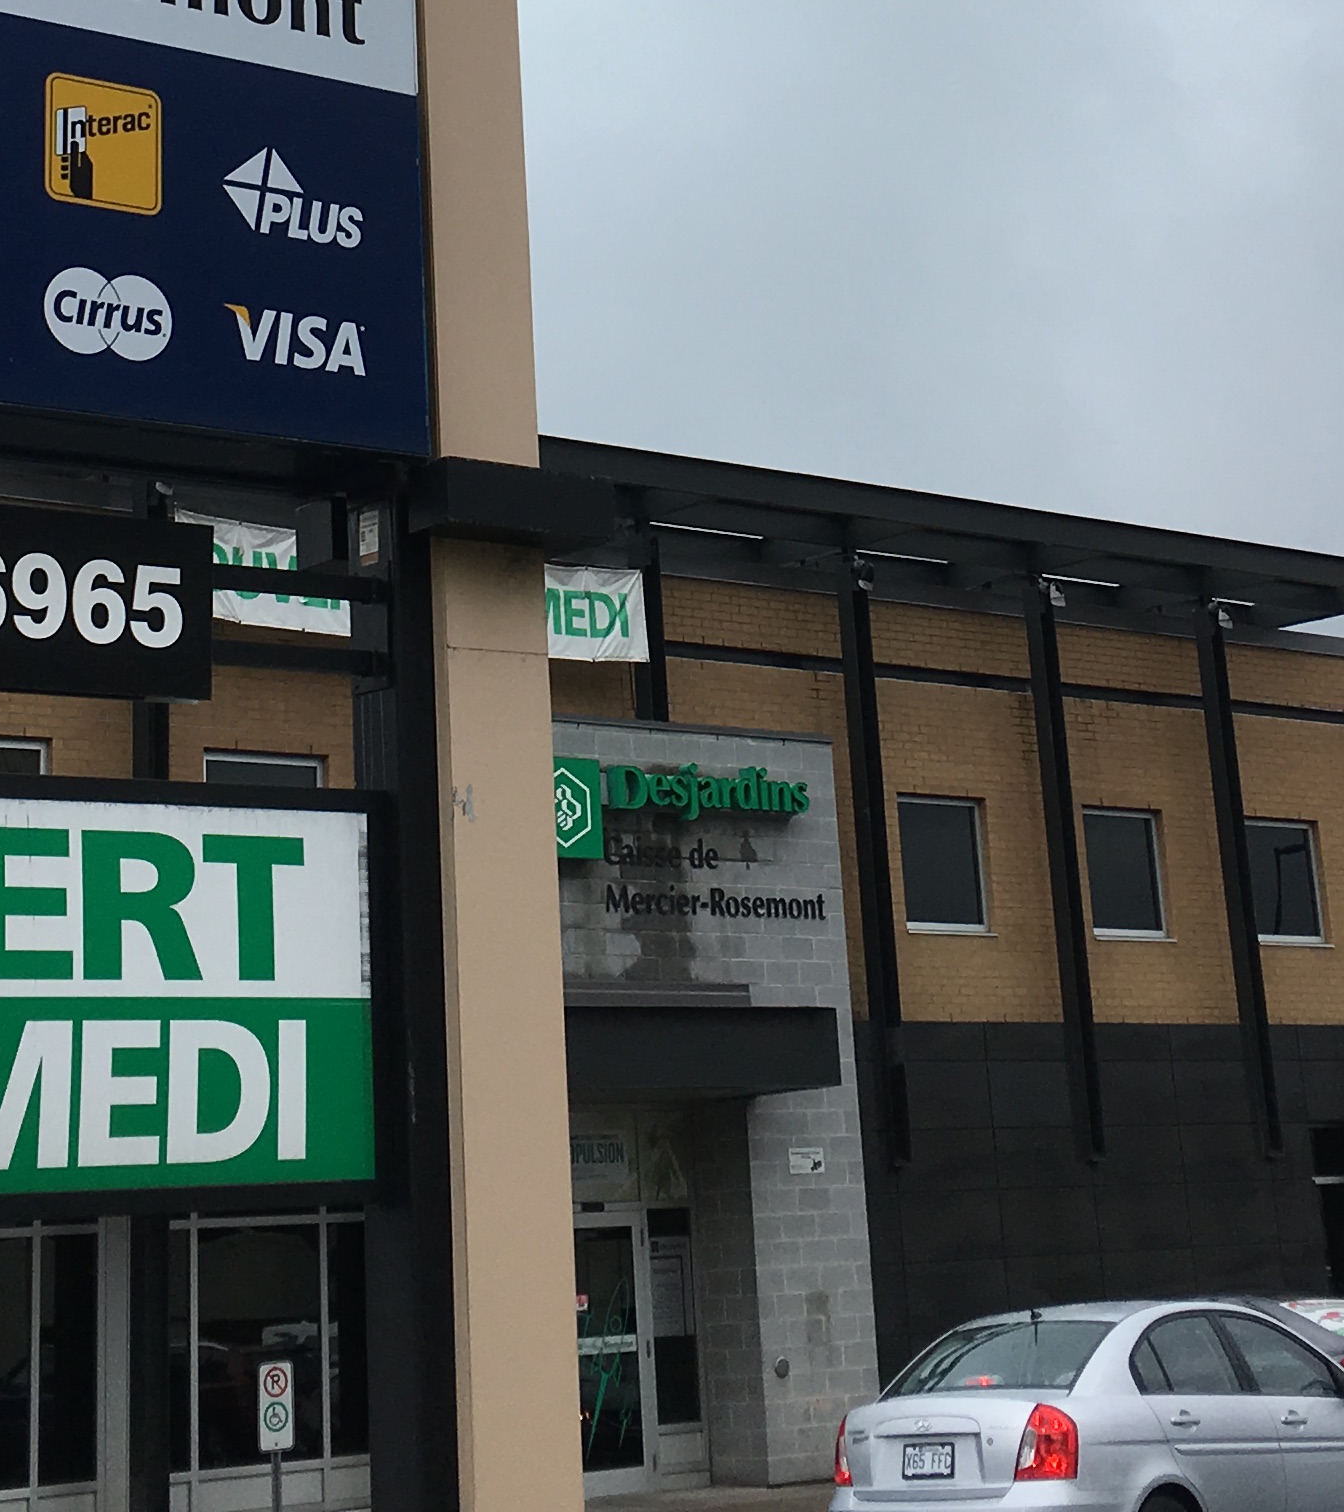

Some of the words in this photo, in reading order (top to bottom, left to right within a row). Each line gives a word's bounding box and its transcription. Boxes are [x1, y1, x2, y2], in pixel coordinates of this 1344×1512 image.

[62, 107, 151, 155] Interac
[260, 193, 364, 248] PLUS
[53, 289, 164, 337] Cirrus
[224, 303, 366, 377] VISA
[607, 763, 809, 820] Desjardins
[689, 839, 718, 870] de
[606, 884, 826, 920] Mercier-Rosemont
